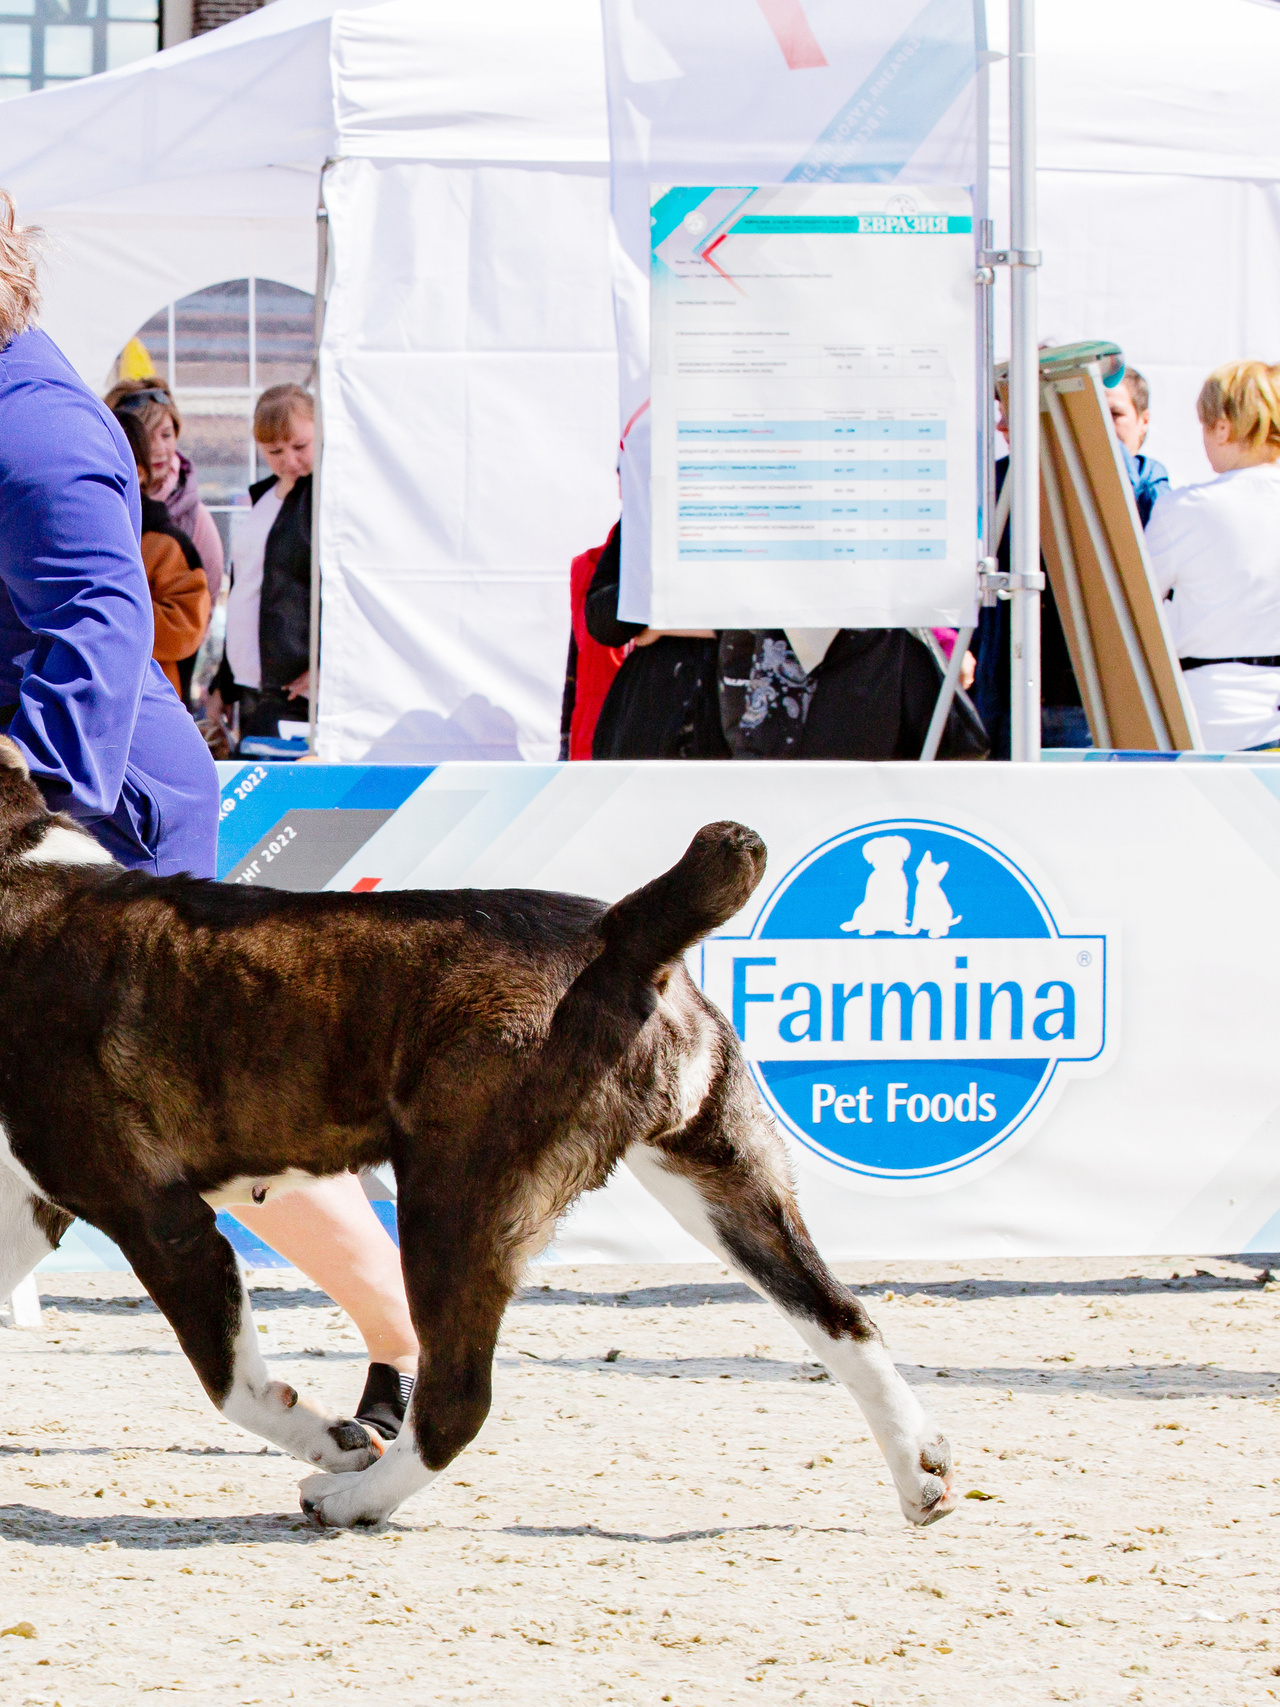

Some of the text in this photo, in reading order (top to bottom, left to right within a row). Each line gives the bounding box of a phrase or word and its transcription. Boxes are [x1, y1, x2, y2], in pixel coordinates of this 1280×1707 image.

[857, 216, 949, 233] ЕВРАЗИЯ
[233, 766, 268, 800] 2022
[235, 826, 297, 883] НГ 2022
[731, 955, 1076, 1043] Farmina
[812, 1082, 997, 1124] Pet Foods
